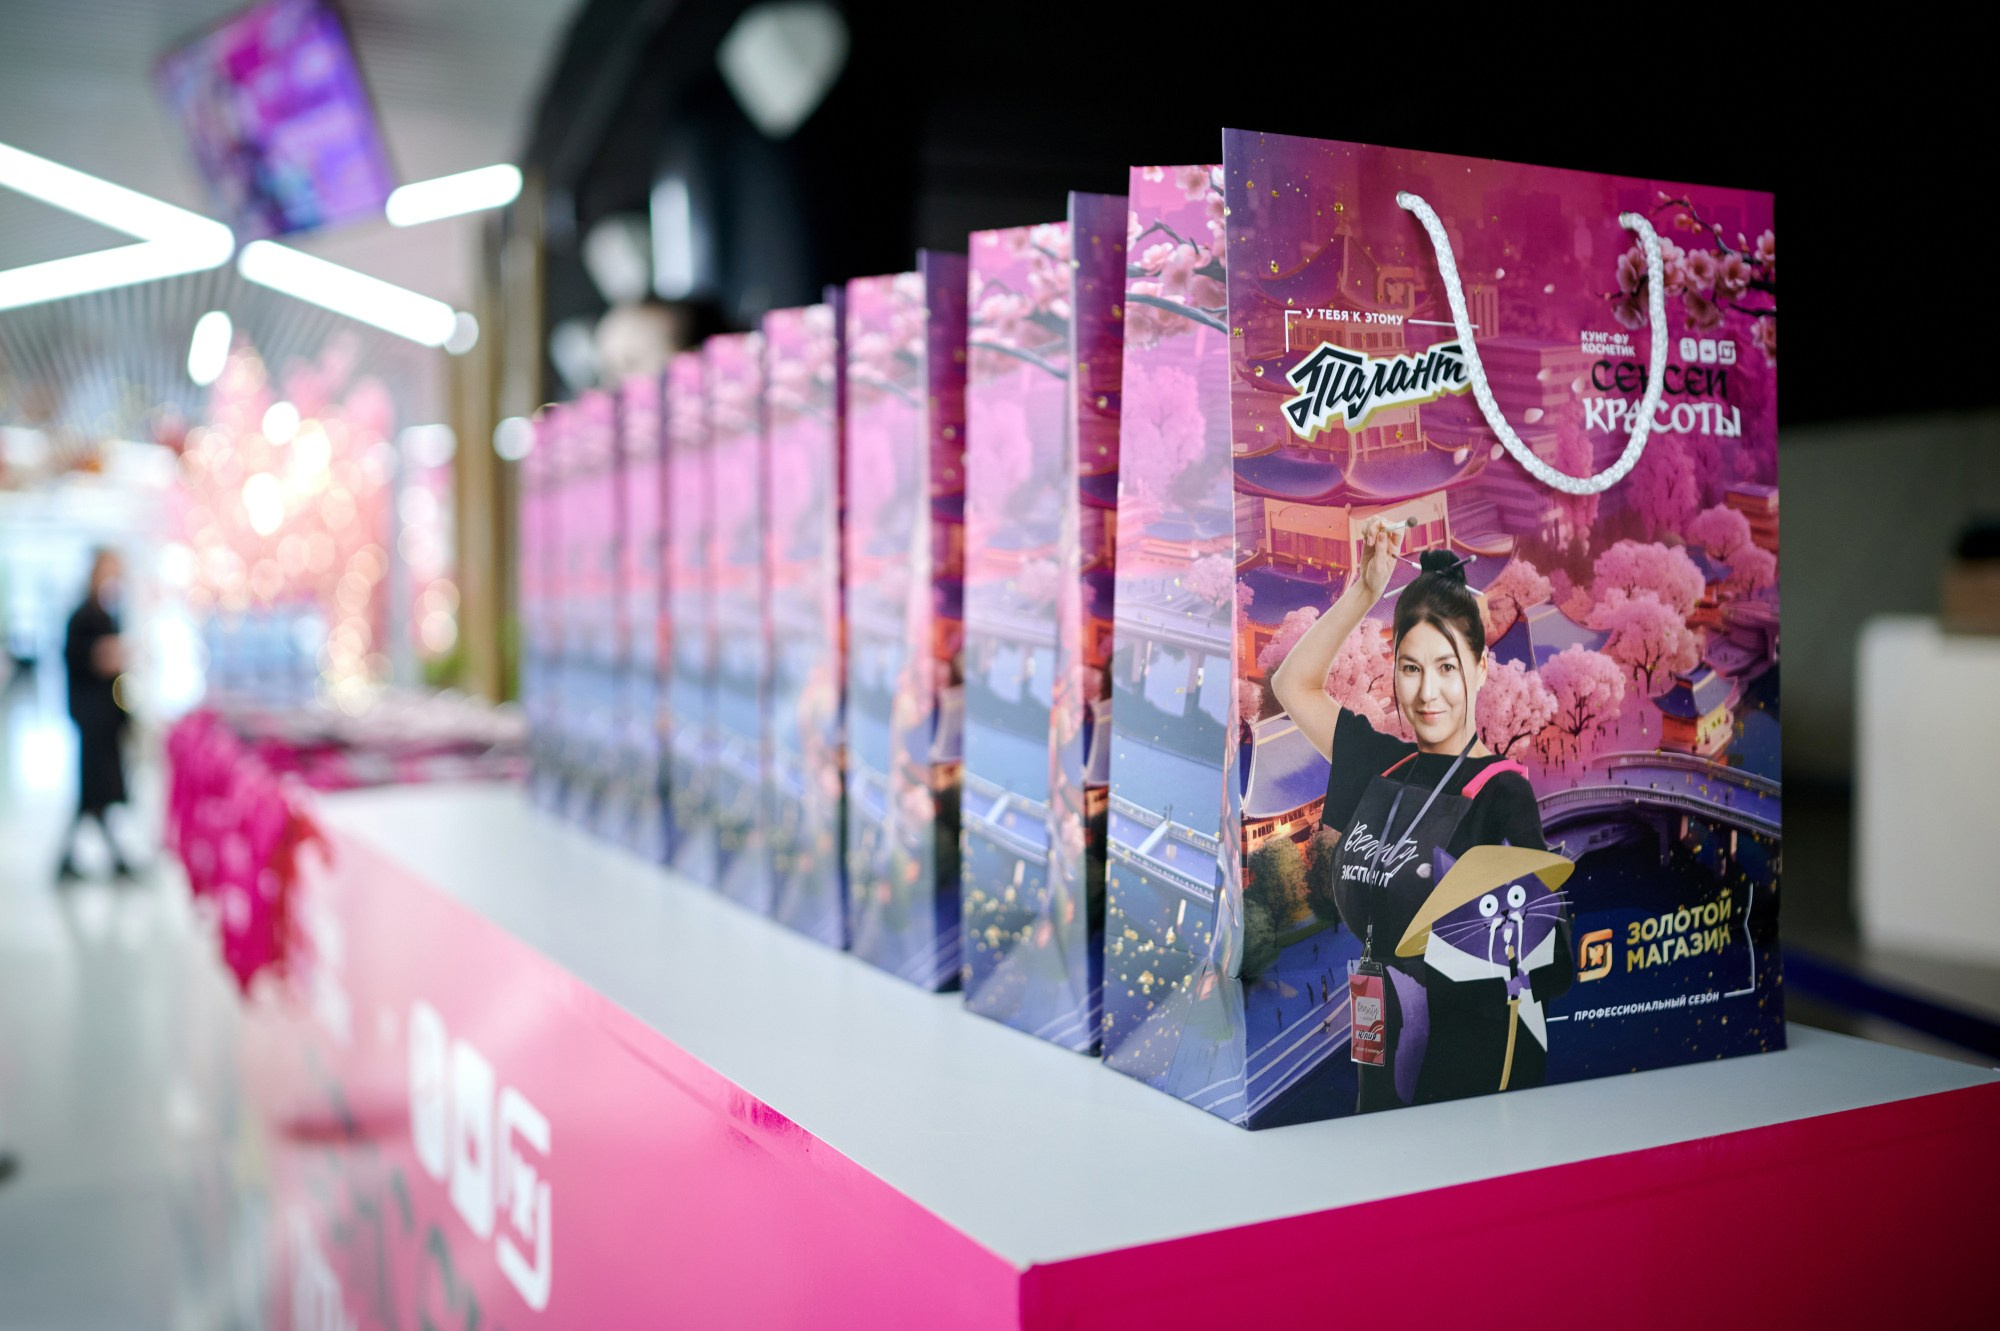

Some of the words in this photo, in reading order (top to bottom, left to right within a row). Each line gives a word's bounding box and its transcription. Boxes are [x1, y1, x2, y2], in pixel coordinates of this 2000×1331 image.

[1305, 308, 1314, 319] У
[1317, 308, 1349, 321] ТЕБЯ
[1353, 312, 1361, 323] К
[1365, 312, 1404, 325] ЭТОМУ
[1580, 330, 1629, 346] КУНГ-ФУ
[1581, 342, 1636, 357] КОСМЕТИК
[1582, 397, 1742, 437] КРАСОТЫ
[1626, 890, 1732, 945] ЗОЛОТОЙ
[1627, 923, 1732, 973] МАГАЗИН
[1574, 994, 1687, 1021] ПРОФЕССИОНАЛЬНЫЙ
[1688, 991, 1720, 1006] СЕЗОН
